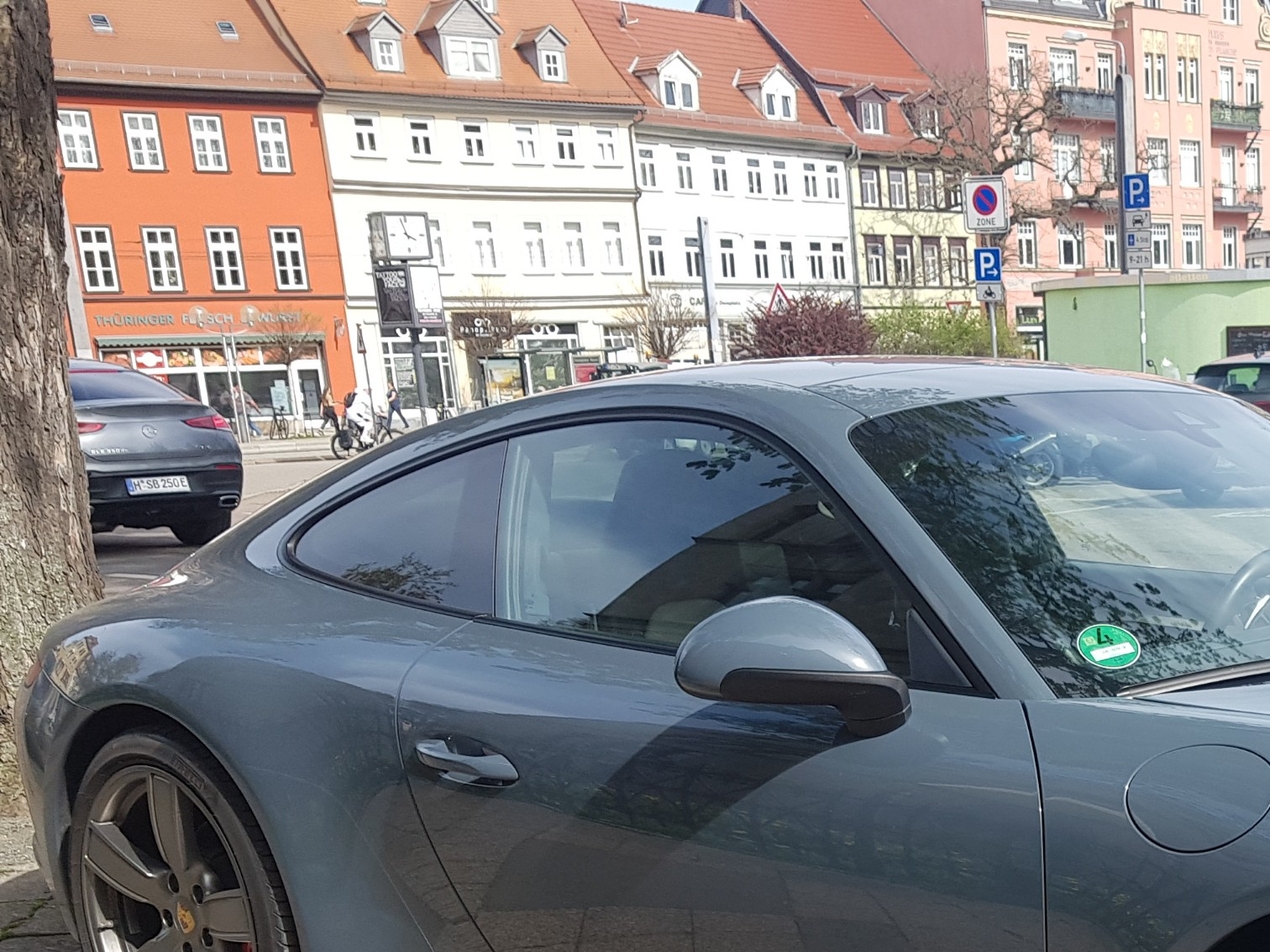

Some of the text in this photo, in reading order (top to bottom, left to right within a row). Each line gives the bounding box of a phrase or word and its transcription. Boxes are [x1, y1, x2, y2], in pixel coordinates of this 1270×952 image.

[1129, 178, 1144, 205] P
[976, 218, 996, 226] ZONE
[979, 252, 995, 277] P
[94, 312, 174, 327] THÜRINGER
[133, 478, 142, 490] H
[146, 478, 159, 490] SB
